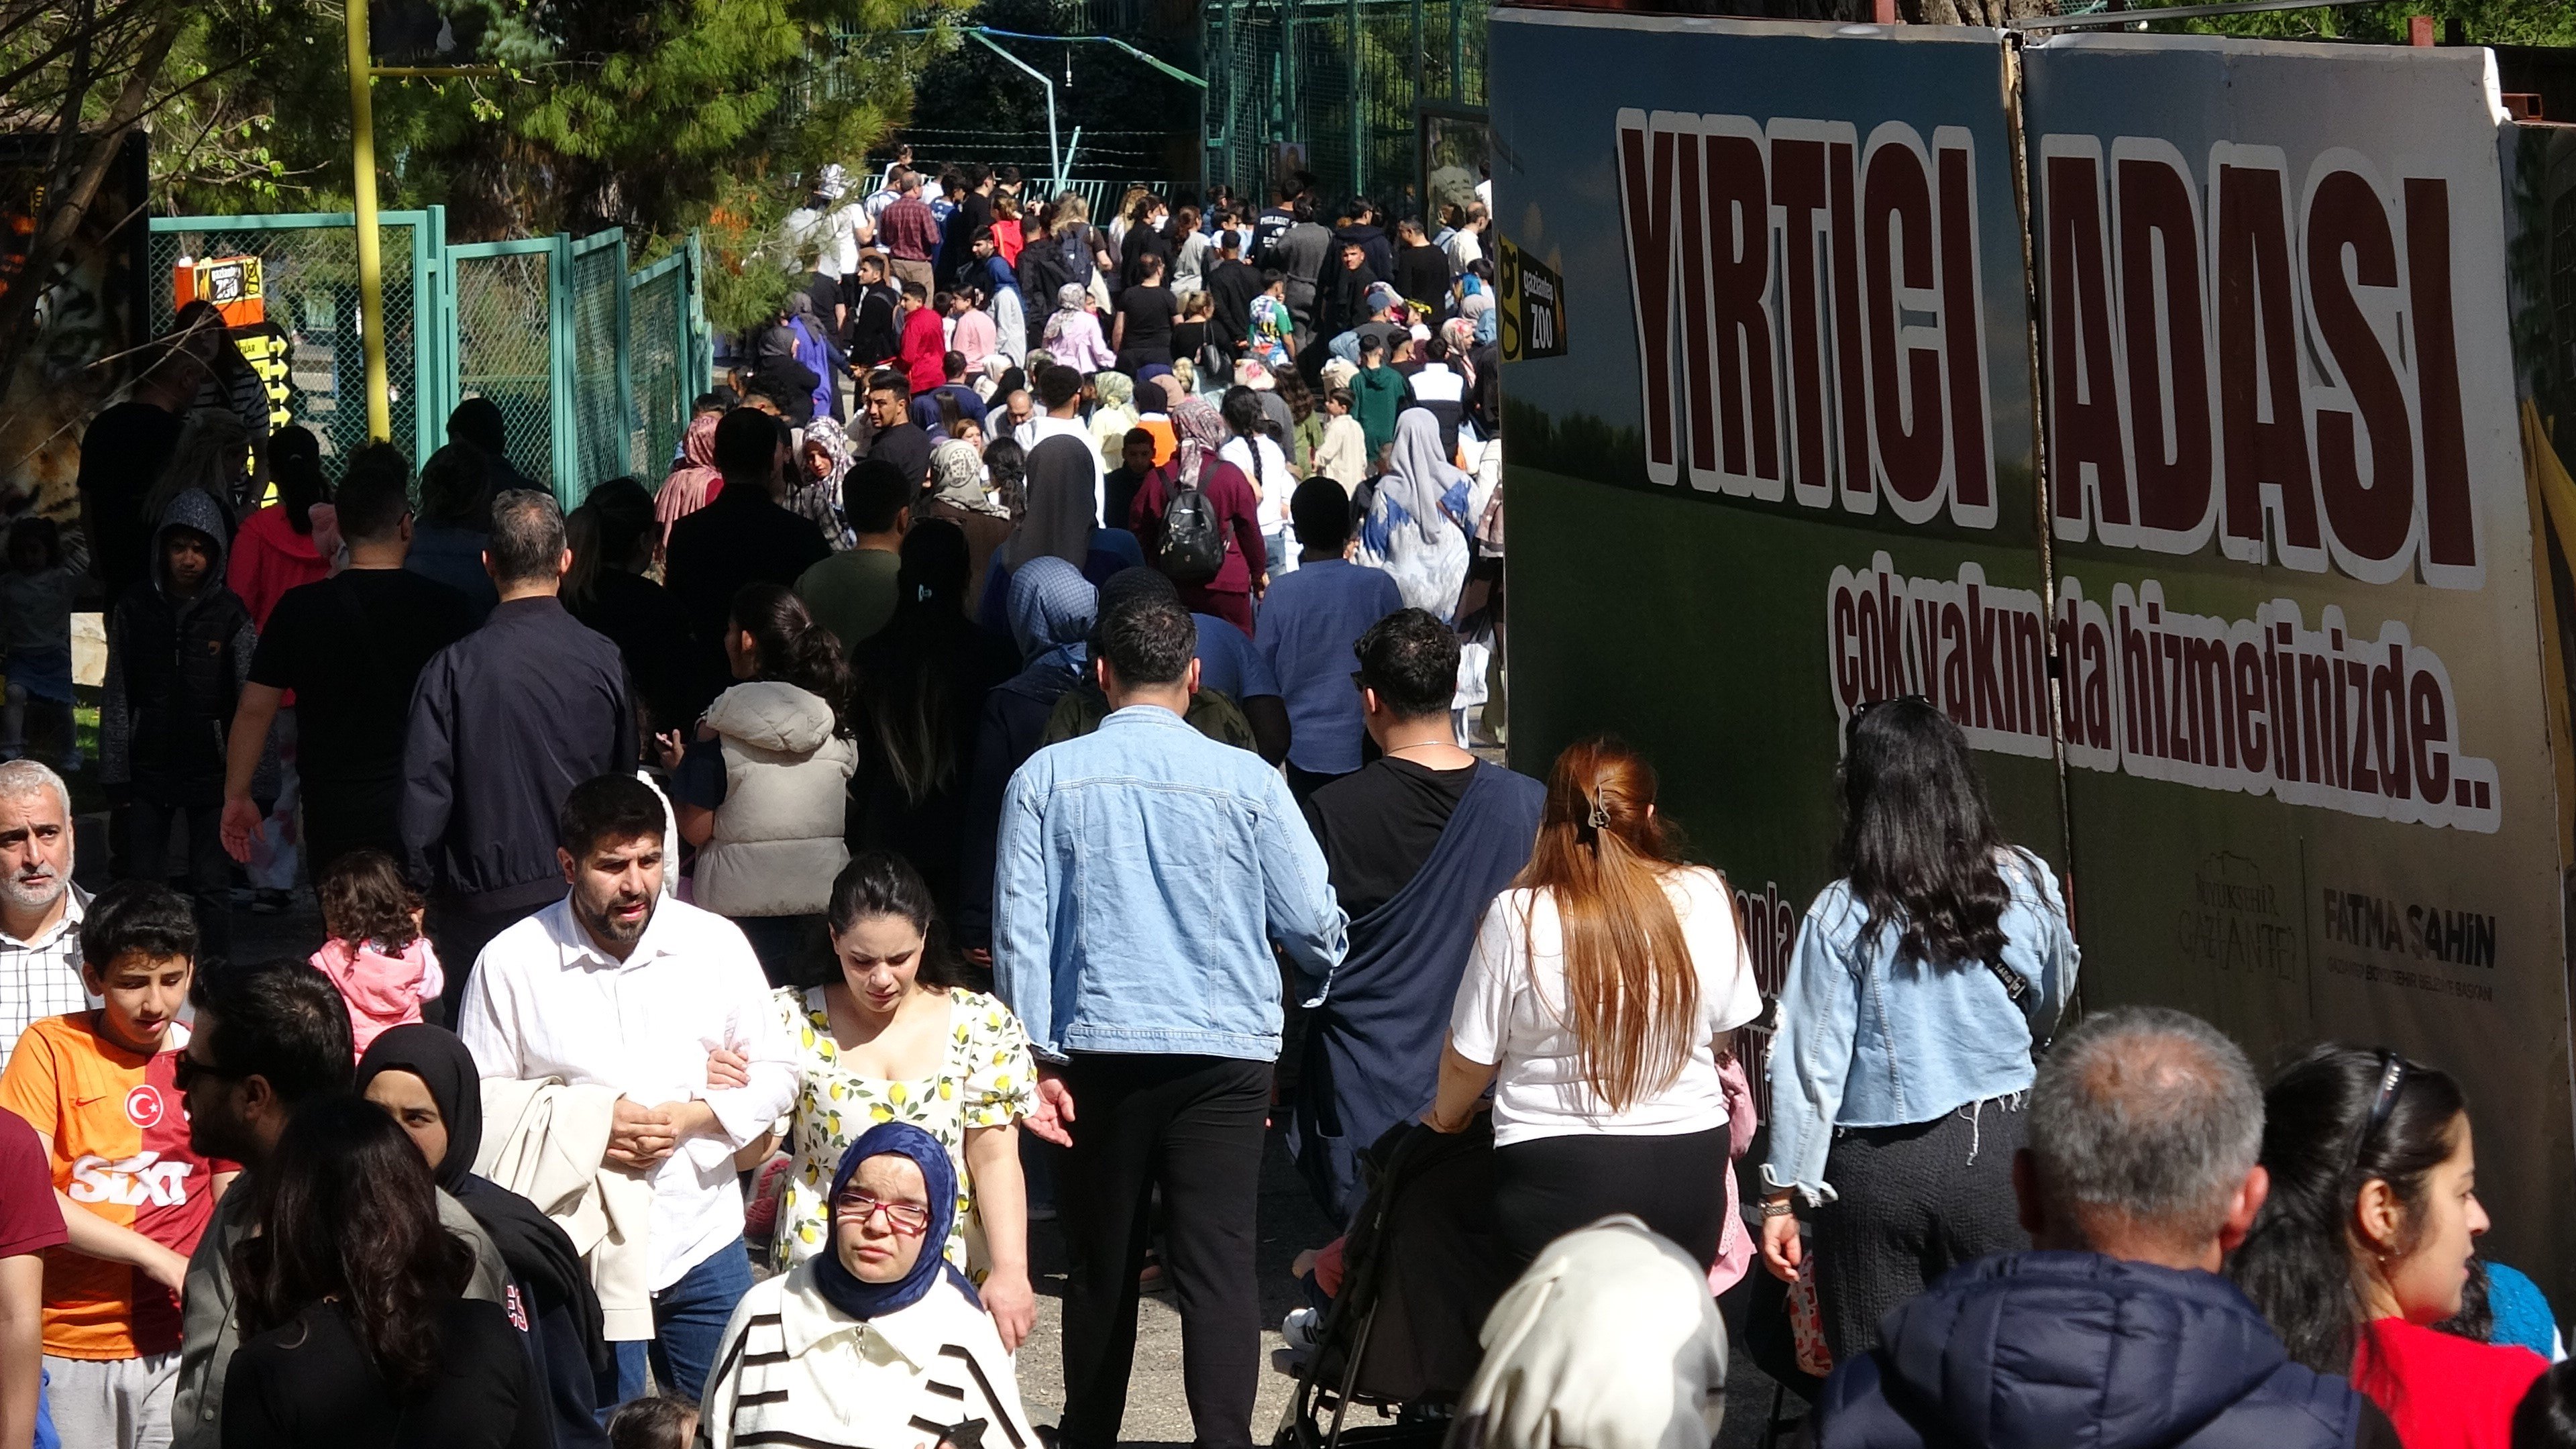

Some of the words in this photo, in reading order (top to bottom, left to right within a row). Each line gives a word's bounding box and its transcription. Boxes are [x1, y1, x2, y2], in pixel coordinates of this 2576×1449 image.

[1530, 303, 1553, 349] ZOO
[1619, 125, 1991, 511] YIRTICI
[2046, 154, 2478, 569] ADASI
[2323, 886, 2405, 953] FATMA
